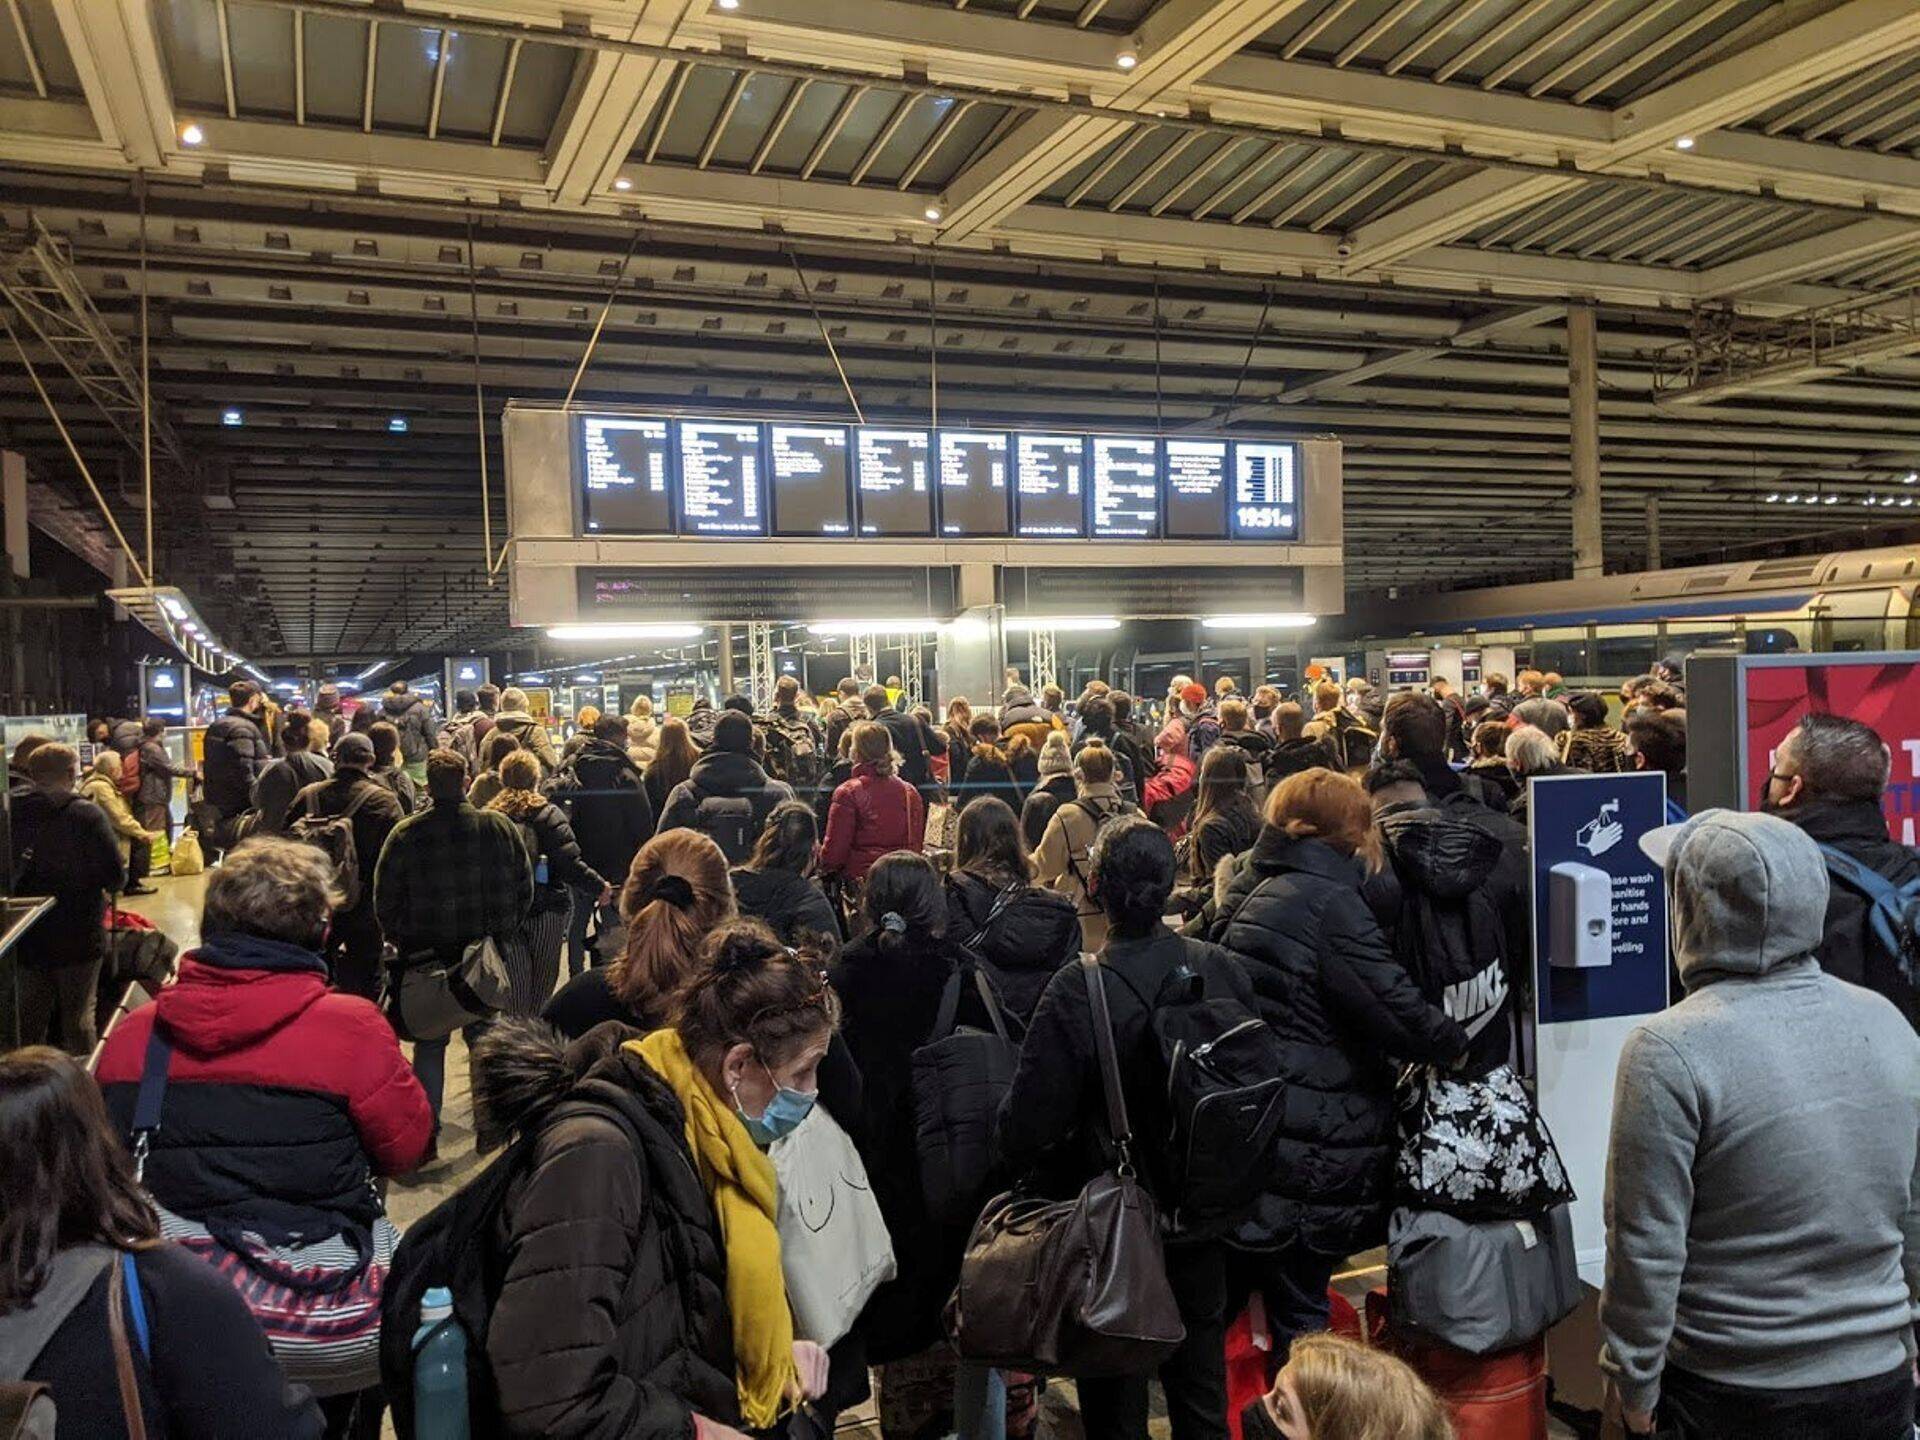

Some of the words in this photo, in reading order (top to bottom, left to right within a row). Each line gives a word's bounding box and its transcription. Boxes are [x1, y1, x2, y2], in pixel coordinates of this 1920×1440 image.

[1611, 877, 1628, 885] ase
[1629, 874, 1654, 884] wash
[1621, 901, 1649, 912] hands
[1631, 914, 1648, 925] and
[1612, 942, 1644, 954] velling
